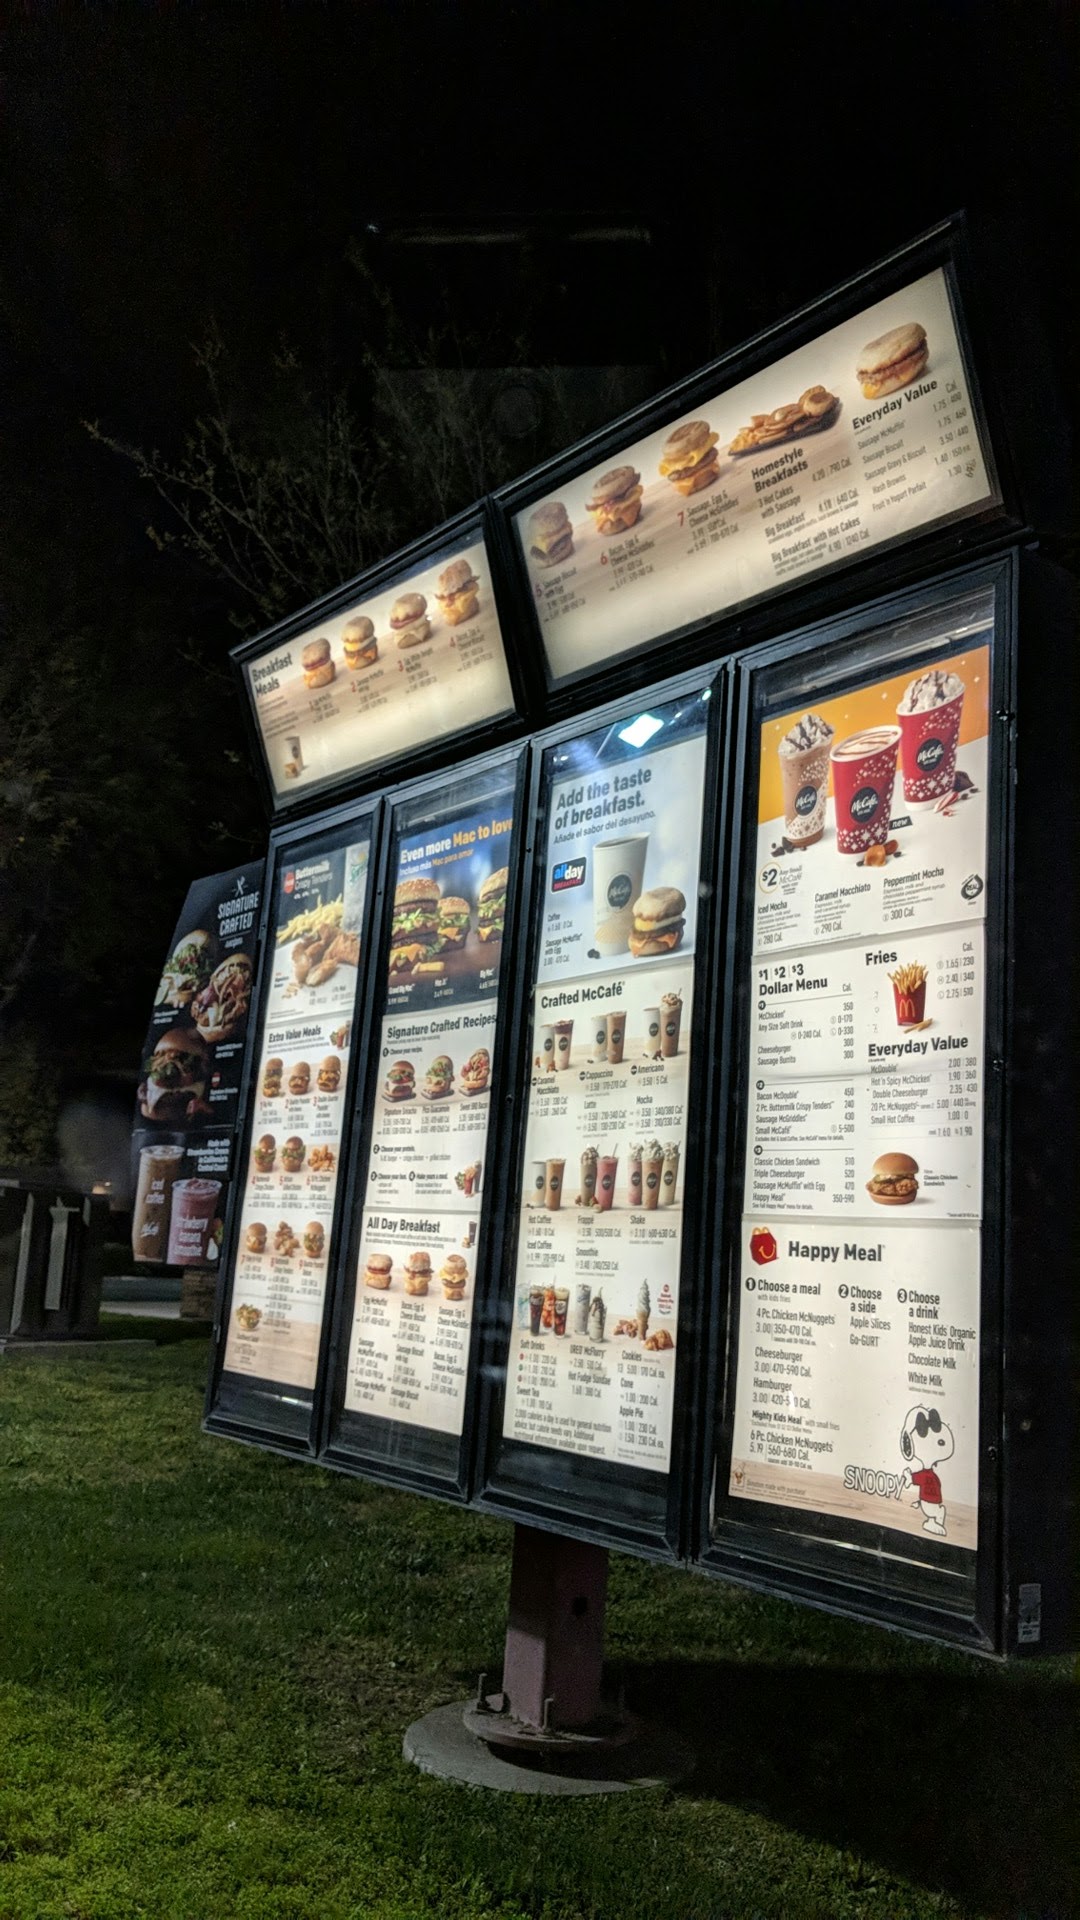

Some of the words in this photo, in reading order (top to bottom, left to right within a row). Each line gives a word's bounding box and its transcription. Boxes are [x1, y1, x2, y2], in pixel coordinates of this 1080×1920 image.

[852, 398, 902, 429] Everyday
[904, 380, 937, 402] Value
[863, 449, 885, 464] Sausage
[938, 416, 951, 428] 1.75
[752, 447, 803, 479] Homestyle
[754, 461, 808, 492] Breakfasts
[762, 506, 774, 519] with
[775, 495, 801, 514] Sausage
[677, 511, 684, 526] 7
[771, 551, 782, 562] Big
[782, 536, 811, 558] Breakfast
[813, 531, 827, 543] with
[827, 527, 840, 538] Hot
[840, 517, 861, 532] Cakes
[601, 551, 608, 565] 6
[252, 652, 293, 682] Breakfast
[255, 677, 280, 697] Meals
[557, 786, 584, 810] Add
[587, 782, 610, 800] the
[614, 769, 651, 792] taste
[555, 811, 568, 830] of
[571, 790, 645, 825] breakfast.
[554, 832, 574, 844] Añade
[576, 828, 582, 838] el
[583, 824, 603, 836] sabor
[605, 820, 617, 830] del
[618, 810, 656, 826] desayuno.
[892, 818, 908, 828] new
[401, 847, 424, 864] Even
[426, 839, 451, 856] more
[453, 831, 476, 847] Mac
[477, 826, 490, 840] to
[762, 868, 777, 887] $2
[883, 872, 921, 888] Peppermint
[922, 867, 944, 879] Mocha
[815, 889, 838, 903] Caramel
[840, 883, 871, 897] Macchiato
[218, 891, 259, 919] SIGNATURE
[758, 904, 769, 914] Iced
[770, 901, 787, 912] Mocha
[219, 912, 254, 936] CRAFTED
[865, 950, 897, 966] Fries
[946, 958, 958, 969] 1.65
[963, 956, 974, 966] 230
[759, 969, 768, 980] $1
[774, 966, 786, 978] $2
[792, 963, 804, 975] $3
[541, 990, 579, 1009] Crafted
[582, 981, 623, 1002] McCafé
[759, 982, 793, 996] Dollar
[796, 978, 828, 991] Menu
[759, 1011, 784, 1020] McChicken
[388, 1024, 429, 1039] Signature
[430, 1017, 460, 1033] Crafted
[463, 1014, 497, 1028] Recipes
[791, 1020, 803, 1028] Drink
[269, 1030, 285, 1043] Extra
[285, 1028, 302, 1041] Value
[302, 1025, 321, 1038] Meals
[758, 1045, 791, 1055] Cheeseburger
[868, 1039, 928, 1057] Everyday
[931, 1036, 968, 1051] Value
[637, 1065, 664, 1074] Americano
[758, 1057, 778, 1066] Sausage
[871, 1064, 897, 1073] McDouble
[585, 1070, 613, 1080] Cappuccino
[773, 1091, 797, 1099] McDouble
[873, 1089, 891, 1099] Double
[892, 1088, 928, 1098] Cheeseburger
[950, 1084, 962, 1094] 2.35
[966, 1083, 977, 1092] 430
[636, 1096, 653, 1104] Mocha
[756, 1115, 777, 1124] Sausage
[779, 1114, 806, 1122] McGriddles
[754, 1157, 773, 1166] Classic
[774, 1157, 794, 1166] Chicken
[796, 1157, 820, 1166] Sandwich
[754, 1169, 768, 1178] Triple
[770, 1169, 805, 1179] Cheeseburger
[753, 1181, 776, 1191] Sausage
[815, 1182, 825, 1191] Egg
[753, 1193, 769, 1202] Happy
[771, 1193, 784, 1201] Meal
[367, 1217, 380, 1229] All
[382, 1218, 398, 1232] Day
[400, 1219, 440, 1233] Breakfast
[630, 1215, 645, 1224] Shake
[789, 1241, 839, 1263] Happy
[844, 1244, 882, 1261] Meal
[758, 1279, 789, 1293] Choose
[792, 1284, 797, 1293] a
[800, 1283, 821, 1295] meal
[850, 1286, 882, 1300] Choose
[909, 1291, 940, 1305] Choose
[850, 1302, 855, 1312] a
[858, 1301, 876, 1313] side
[909, 1307, 914, 1317] a
[916, 1305, 938, 1319] drink
[756, 1308, 760, 1317] 4
[772, 1309, 797, 1321] Chicken
[799, 1312, 835, 1325] McNuggets
[850, 1316, 869, 1329] Apple
[871, 1318, 891, 1330] Slices
[756, 1322, 771, 1333] 3.00
[774, 1324, 800, 1336] 350-470
[908, 1322, 931, 1334] Honest
[933, 1325, 947, 1336] Kids
[950, 1326, 976, 1340] Organic
[850, 1334, 878, 1347] Go-GURT
[908, 1334, 926, 1347] Apple
[928, 1337, 946, 1349] Juice
[948, 1339, 965, 1351] Drink
[622, 1350, 642, 1361] Cookies
[755, 1346, 803, 1363] Cheeseburger
[908, 1353, 941, 1367] Chocolate
[943, 1358, 956, 1369] Milk
[754, 1361, 769, 1373] 3.00
[772, 1364, 799, 1376] 470-590
[621, 1378, 633, 1388] Cone
[753, 1377, 792, 1392] Hamburger
[908, 1371, 927, 1385] White
[929, 1375, 943, 1387] Milk
[619, 1406, 634, 1417] Apple
[635, 1408, 643, 1418] Pie
[751, 1430, 755, 1440] 6
[767, 1432, 793, 1445] Chicken
[795, 1437, 833, 1453] McNuggets
[768, 1444, 796, 1458] 560-680
[844, 1465, 905, 1499] SNOOPY
